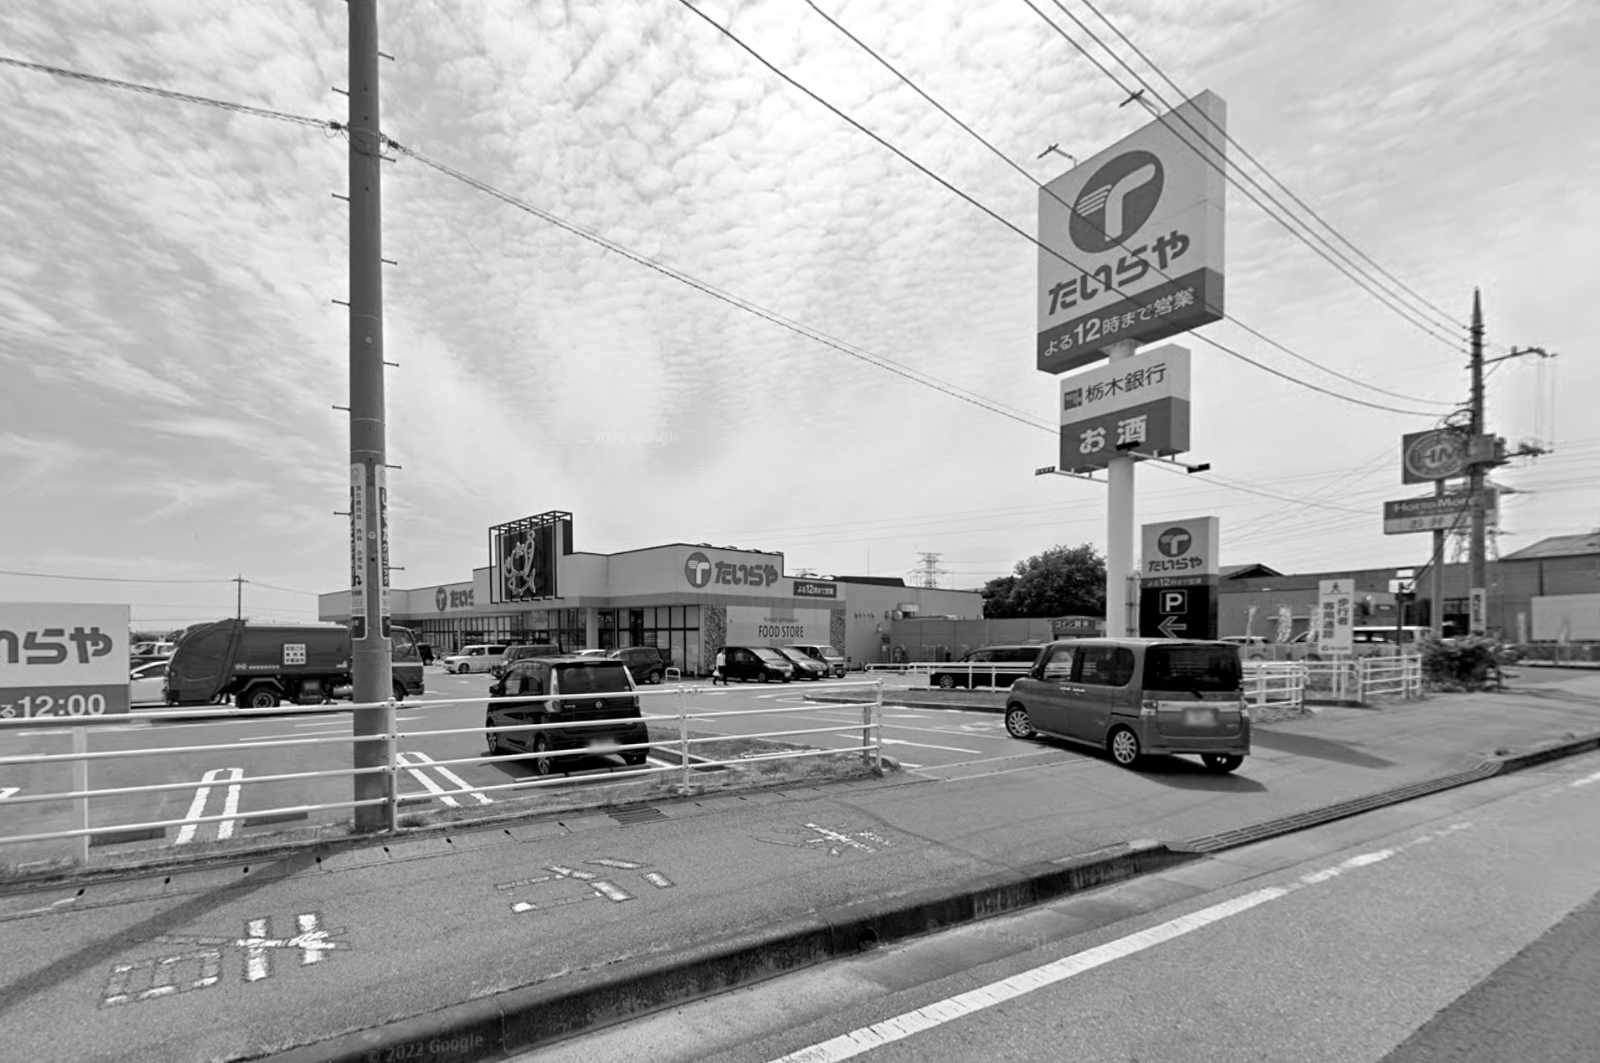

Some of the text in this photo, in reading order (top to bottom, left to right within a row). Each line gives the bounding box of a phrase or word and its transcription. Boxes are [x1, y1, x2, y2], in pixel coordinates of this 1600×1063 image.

[1048, 229, 1190, 316] たいらや
[1044, 287, 1195, 357] よる12時まで営業
[1085, 362, 1167, 403] 栃木銀行
[714, 561, 778, 587] たいらや
[1148, 556, 1203, 573] たいらや
[1165, 593, 1183, 612] P
[758, 625, 804, 638] FOOD STORE
